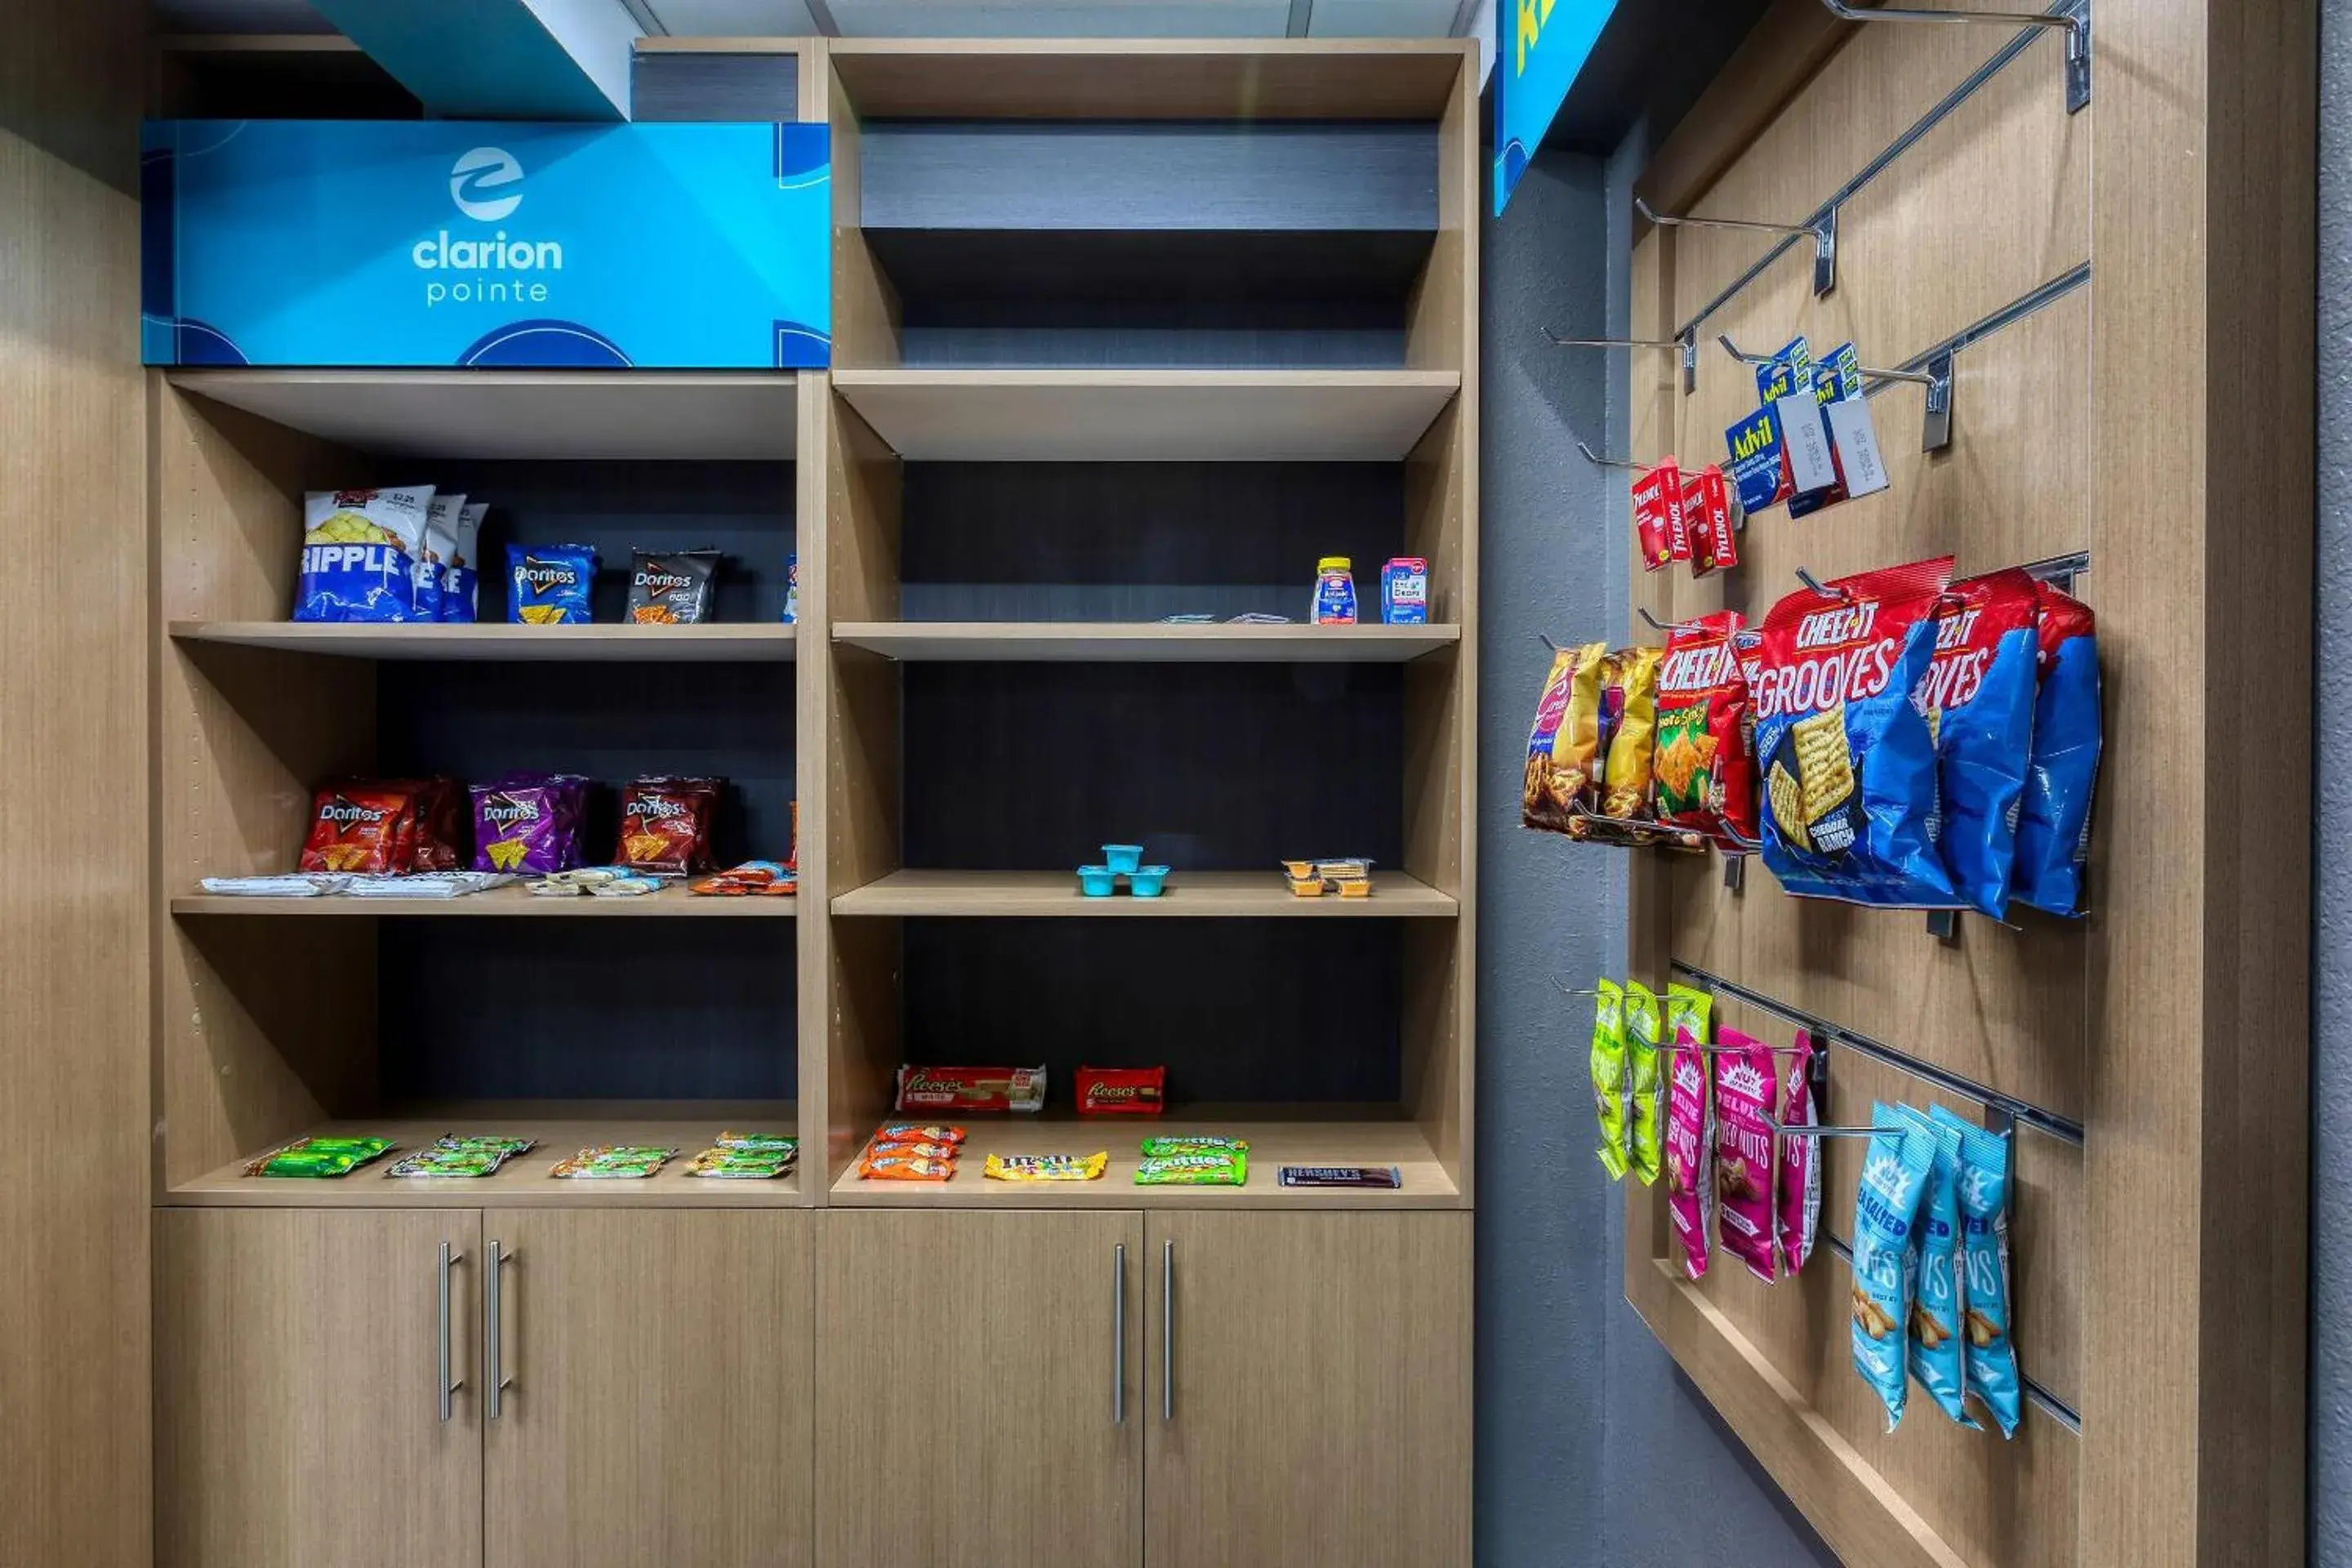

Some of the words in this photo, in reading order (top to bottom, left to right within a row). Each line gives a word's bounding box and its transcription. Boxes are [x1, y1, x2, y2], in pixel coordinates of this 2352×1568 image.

[412, 230, 563, 269] clarion
[427, 277, 548, 307] pointe
[1735, 415, 1773, 461] Advil
[1669, 501, 1688, 554] TYLENOL
[1713, 507, 1732, 560] TYLENOL
[515, 566, 575, 584] Doritos
[635, 572, 692, 587] Doritos
[1757, 637, 1895, 718] GROOVES
[320, 805, 381, 821] Doritos
[483, 806, 539, 822] Doritos
[627, 802, 679, 816] Doritos
[1817, 827, 1855, 853] RANCH
[1739, 1128, 1768, 1169] NUTS
